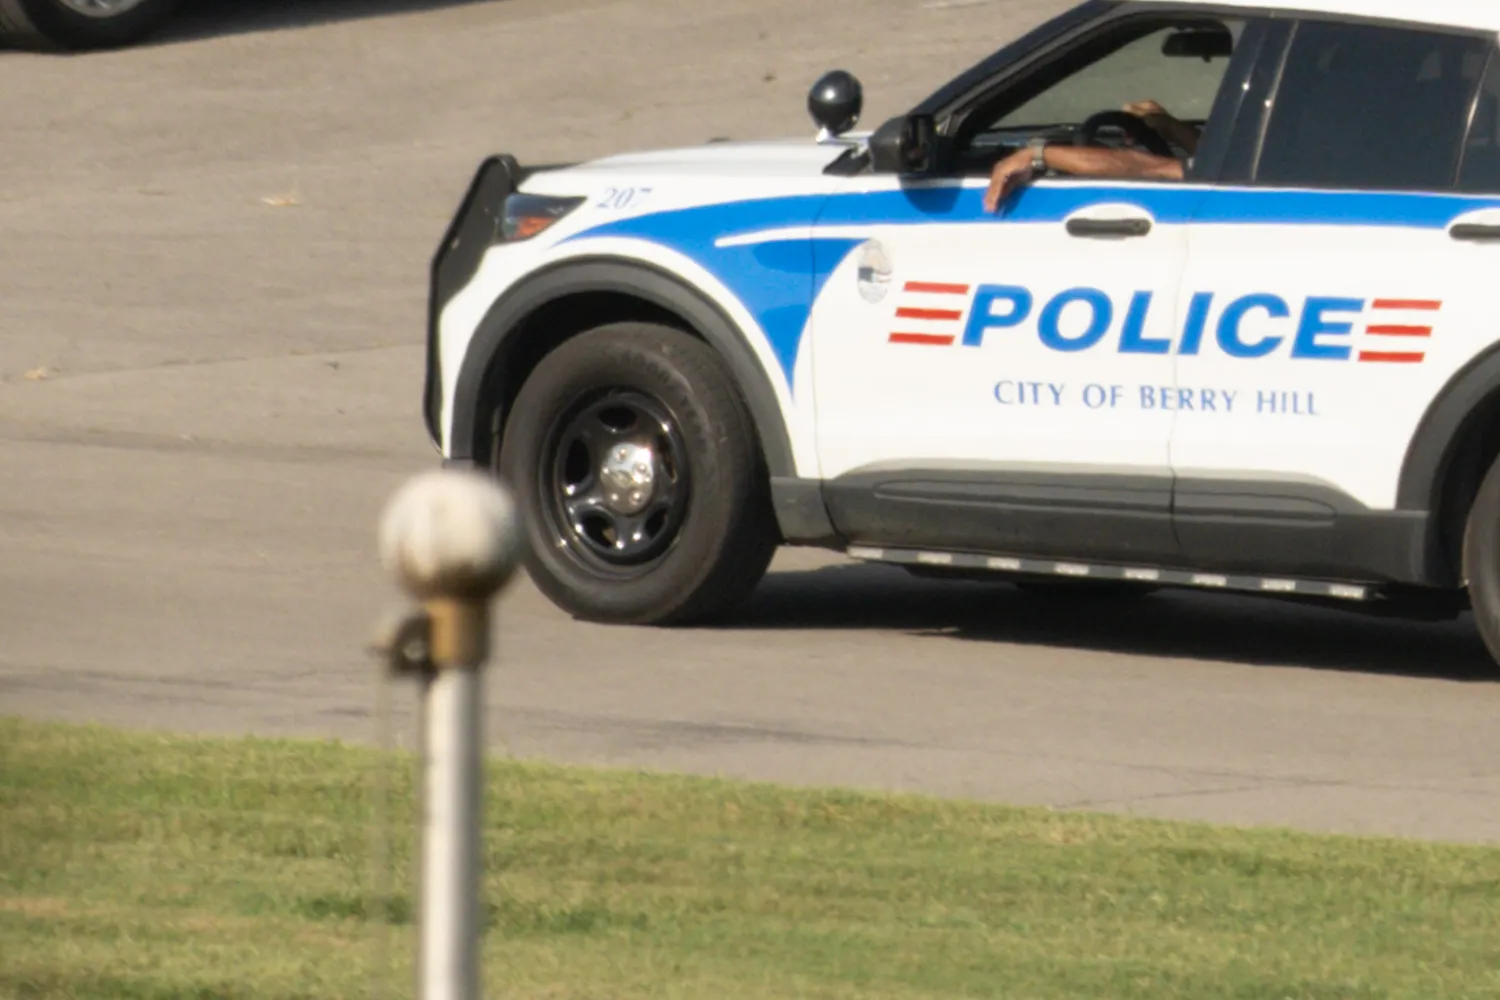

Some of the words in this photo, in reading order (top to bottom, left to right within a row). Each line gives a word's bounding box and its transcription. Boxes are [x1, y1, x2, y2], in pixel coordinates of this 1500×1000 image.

[596, 187, 654, 210] 207
[960, 283, 1366, 362] POLICE
[993, 380, 1067, 407] CITY
[1082, 384, 1125, 410] OF
[1140, 385, 1238, 413] BERRY
[1256, 390, 1319, 416] HILL
